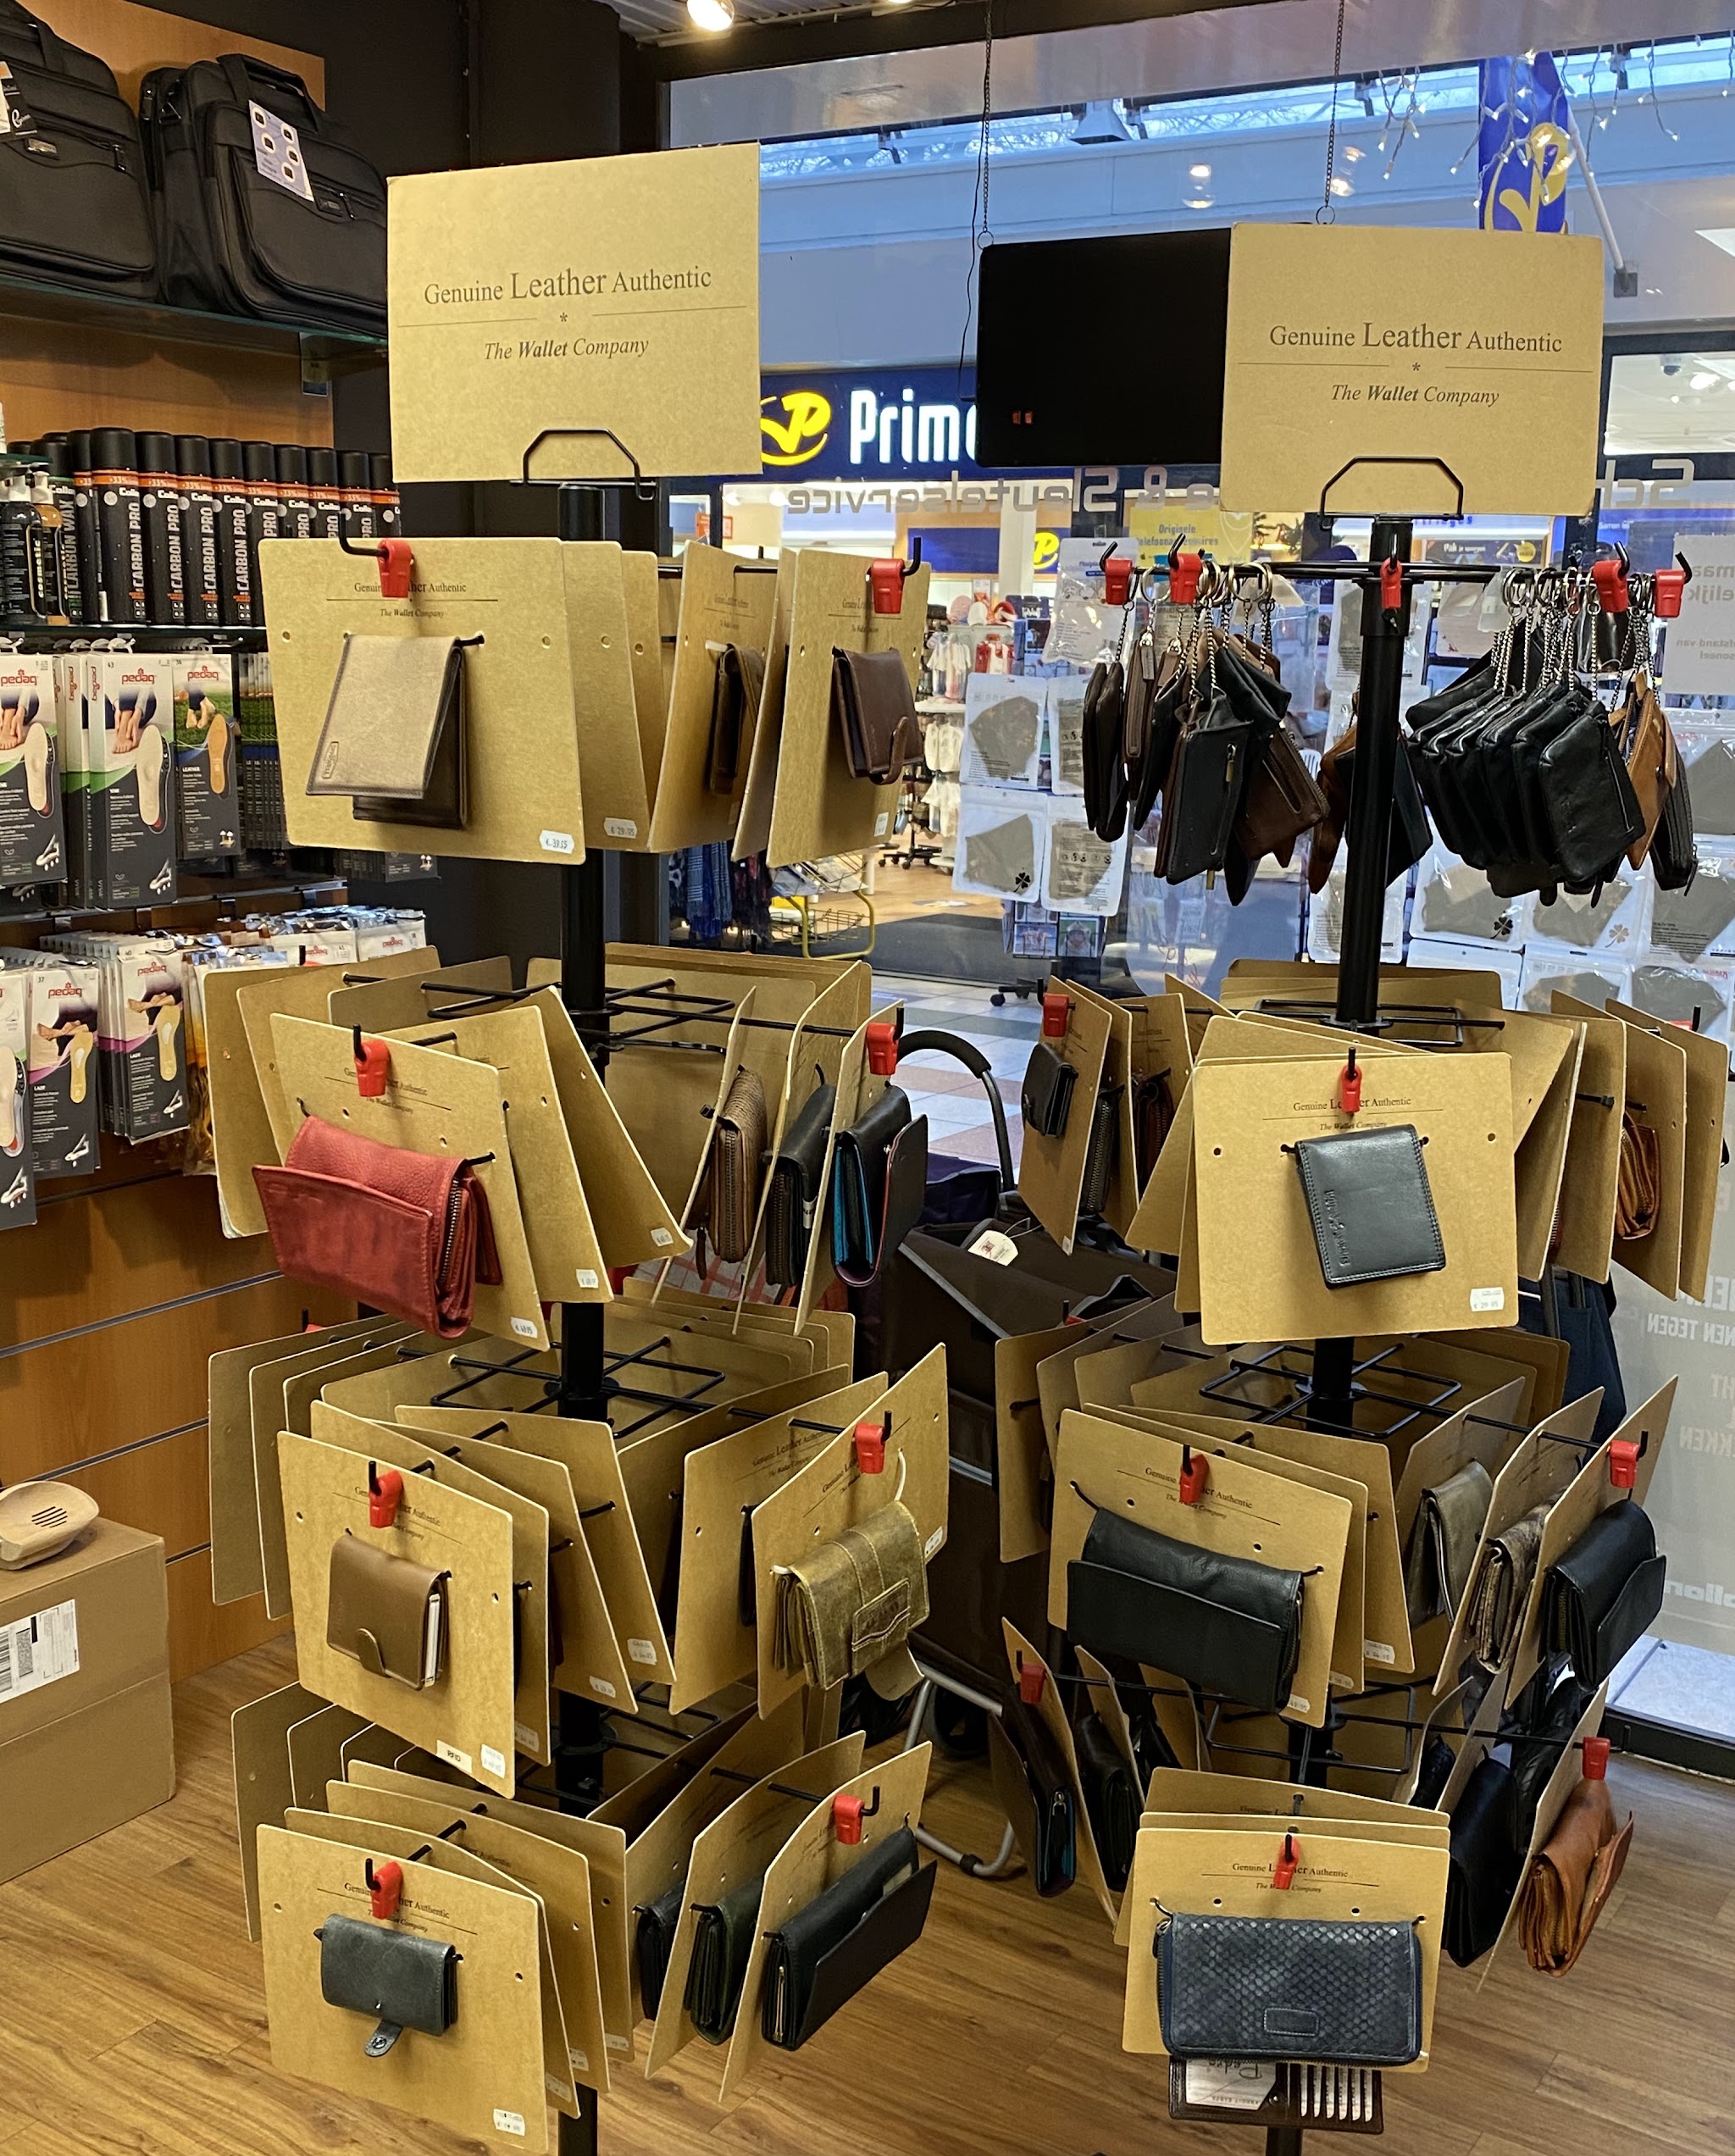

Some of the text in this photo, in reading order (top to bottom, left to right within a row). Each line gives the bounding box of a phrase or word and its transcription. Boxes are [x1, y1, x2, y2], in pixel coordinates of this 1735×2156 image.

[424, 265, 712, 305] Genuine Leather Authentic
[485, 337, 649, 361] The Wallet Company
[1270, 322, 1562, 352] Genuine Leather Authentic
[1331, 384, 1499, 407] The Wallet Company
[850, 387, 977, 464] Prim
[128, 502, 145, 588] CARBON PRO
[166, 505, 184, 590] CARBON PRO
[200, 507, 217, 593] CARBON PRO
[232, 509, 250, 595] CARBON PRO
[33, 539, 44, 598] cosmetic
[429, 583, 467, 592] Authentic
[1293, 1102, 1328, 1111] Genuine
[1371, 1097, 1411, 1107] Authentic
[1216, 1491, 1253, 1509] Authentic
[1309, 1868, 1349, 1877] Authentic
[414, 1902, 450, 1919] Authentic
